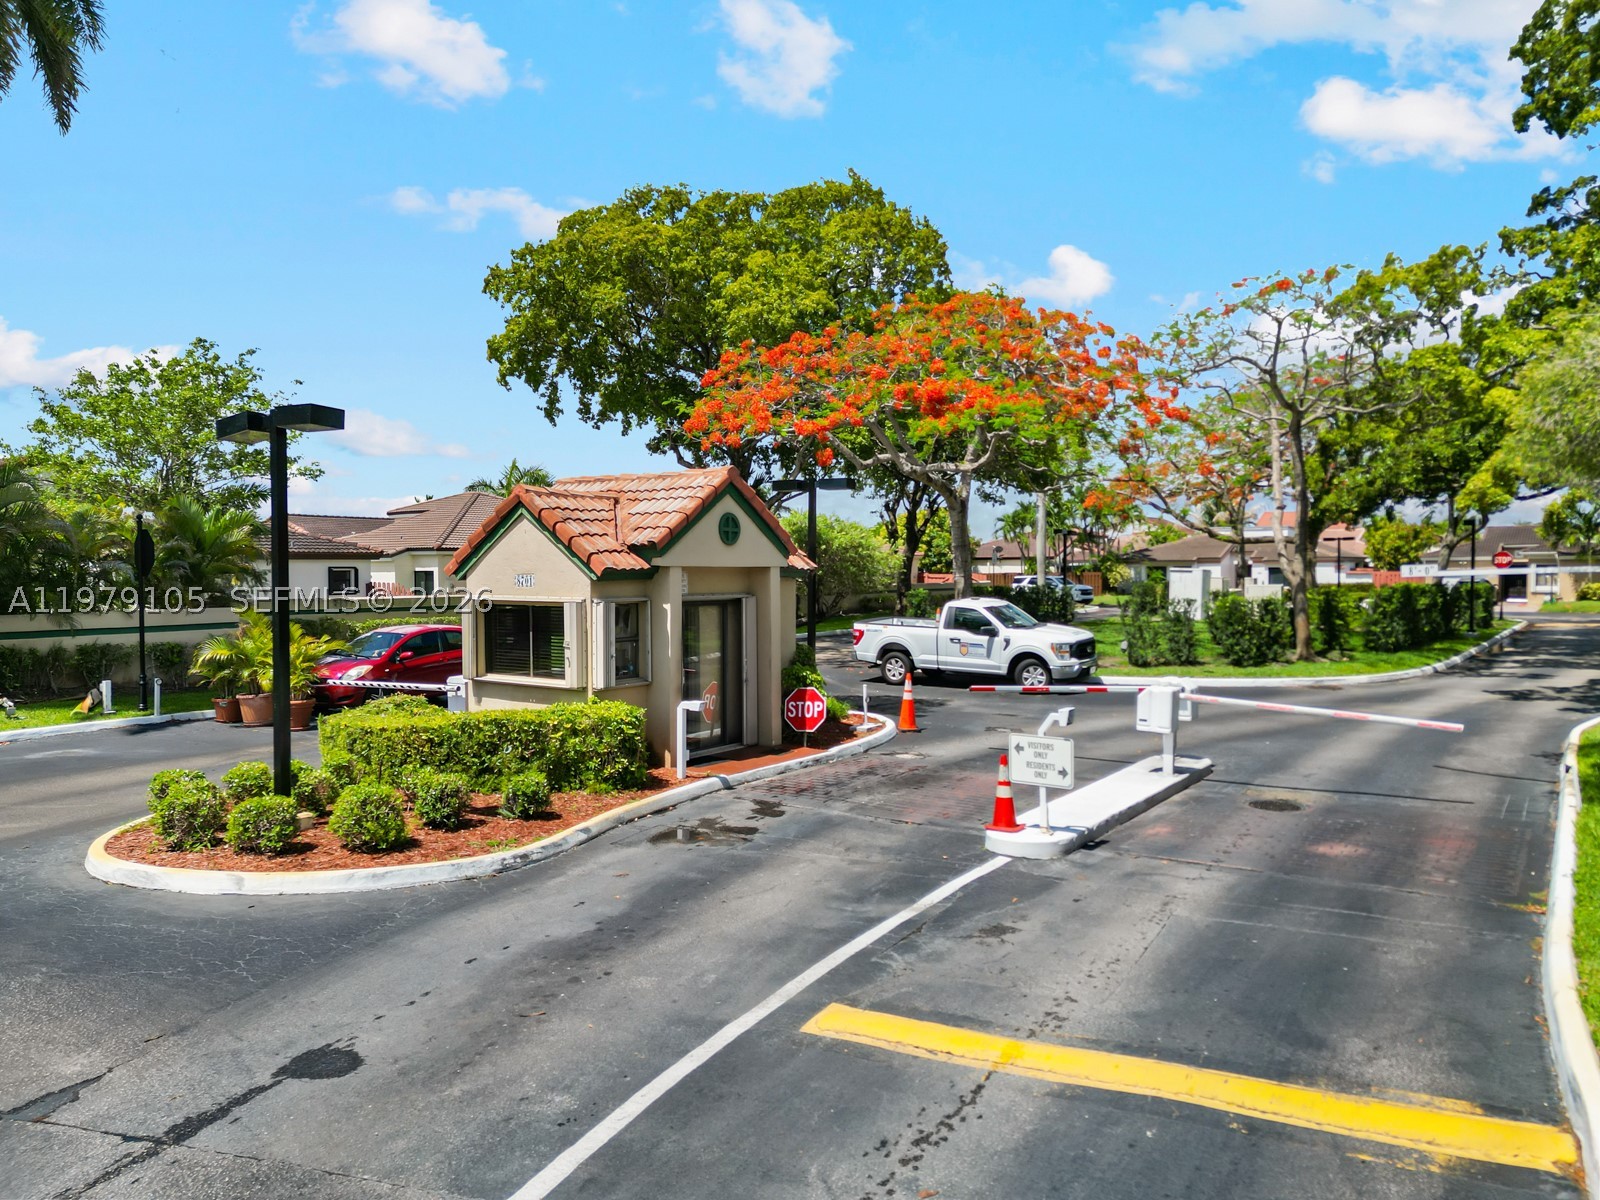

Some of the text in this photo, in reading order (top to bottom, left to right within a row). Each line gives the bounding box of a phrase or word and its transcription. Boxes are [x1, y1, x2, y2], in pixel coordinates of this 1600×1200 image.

[1494, 556, 1513, 564] STOP
[788, 701, 824, 718] STOP
[1027, 742, 1055, 751] VISITORS
[1033, 751, 1048, 759] ONLY
[1026, 761, 1056, 771] RESIDENTS
[1034, 770, 1047, 779] ONLY
